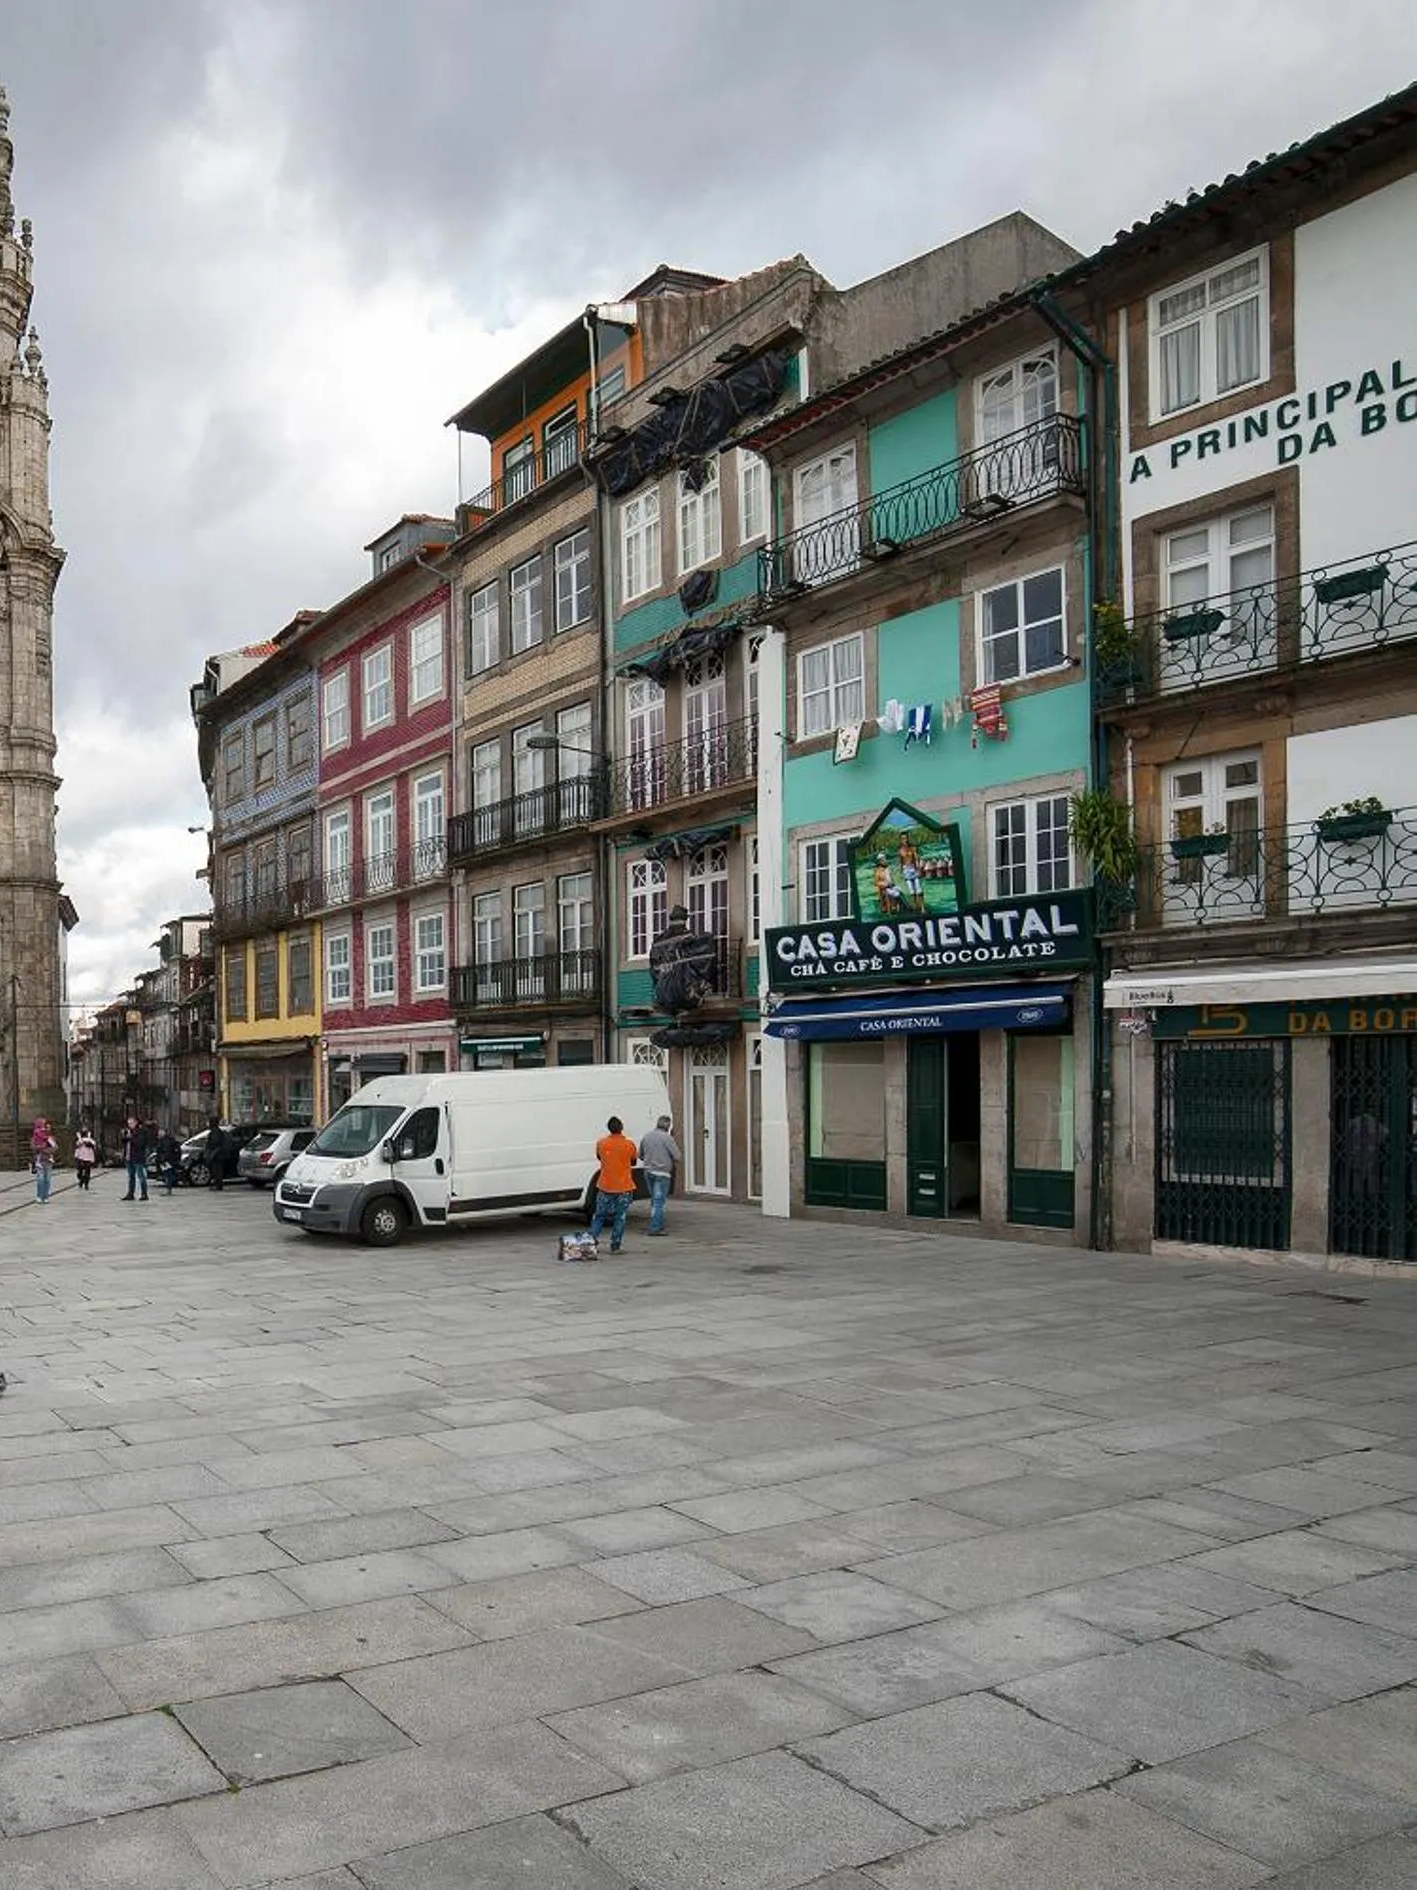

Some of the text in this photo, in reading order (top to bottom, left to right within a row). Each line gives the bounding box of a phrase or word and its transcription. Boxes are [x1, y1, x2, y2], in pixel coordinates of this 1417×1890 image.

[1129, 359, 1417, 484] A PRINCIPAL
[1278, 421, 1337, 466] DA
[776, 904, 1079, 962] CASA ORIENTAL
[890, 956, 904, 969] E
[912, 941, 1056, 967] CHOCOLATE
[860, 1016, 942, 1031] CASA ORIENTAL
[1288, 1011, 1331, 1033] DA
